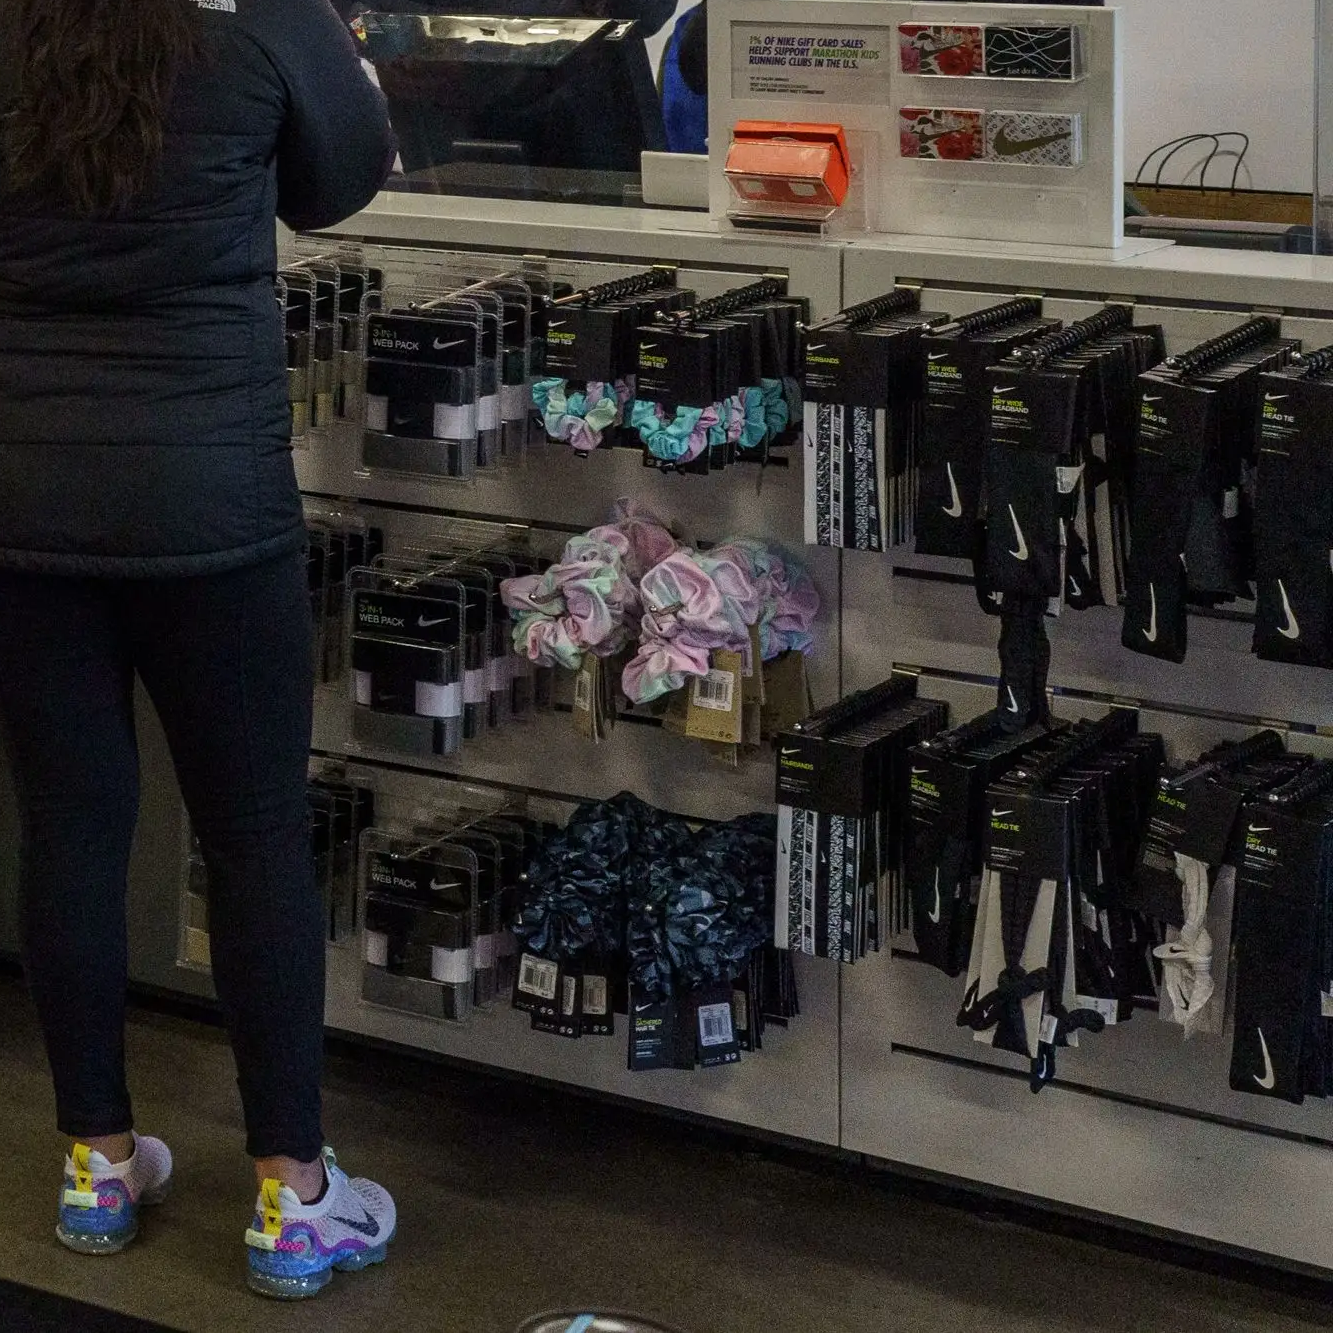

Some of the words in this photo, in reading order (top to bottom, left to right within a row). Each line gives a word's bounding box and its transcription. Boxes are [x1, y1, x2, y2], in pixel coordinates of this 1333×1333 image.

[197, 1, 224, 11] FACE
[750, 35, 762, 45] 1%
[764, 36, 776, 46] OF
[777, 36, 795, 47] NIKE
[797, 37, 816, 47] GIFT
[817, 38, 839, 48] CARD
[749, 47, 772, 56] HELPS
[774, 47, 810, 57] SUPPORT
[811, 48, 859, 59] MARATHON
[860, 50, 880, 59] KIDS
[749, 56, 786, 66] RUNNING
[788, 57, 812, 67] CLUBS
[814, 58, 824, 68] IN
[826, 58, 841, 68] THE
[843, 59, 859, 69] U.S.
[372, 337, 394, 349] WEB
[395, 340, 420, 351] PACK
[928, 371, 962, 379] HEADBAND
[941, 365, 957, 373] WIDE
[992, 398, 1006, 406] DRY
[1007, 399, 1024, 407] WIDE
[992, 404, 1029, 414] HEADBAND
[1263, 412, 1282, 421] HEAD
[1283, 415, 1295, 423] TIE
[359, 613, 380, 624] WEB
[381, 616, 405, 627] PACK
[1246, 843, 1266, 854] HEAD
[1266, 847, 1278, 856] TIE
[372, 873, 392, 884] WEB
[393, 876, 417, 889] PACK
